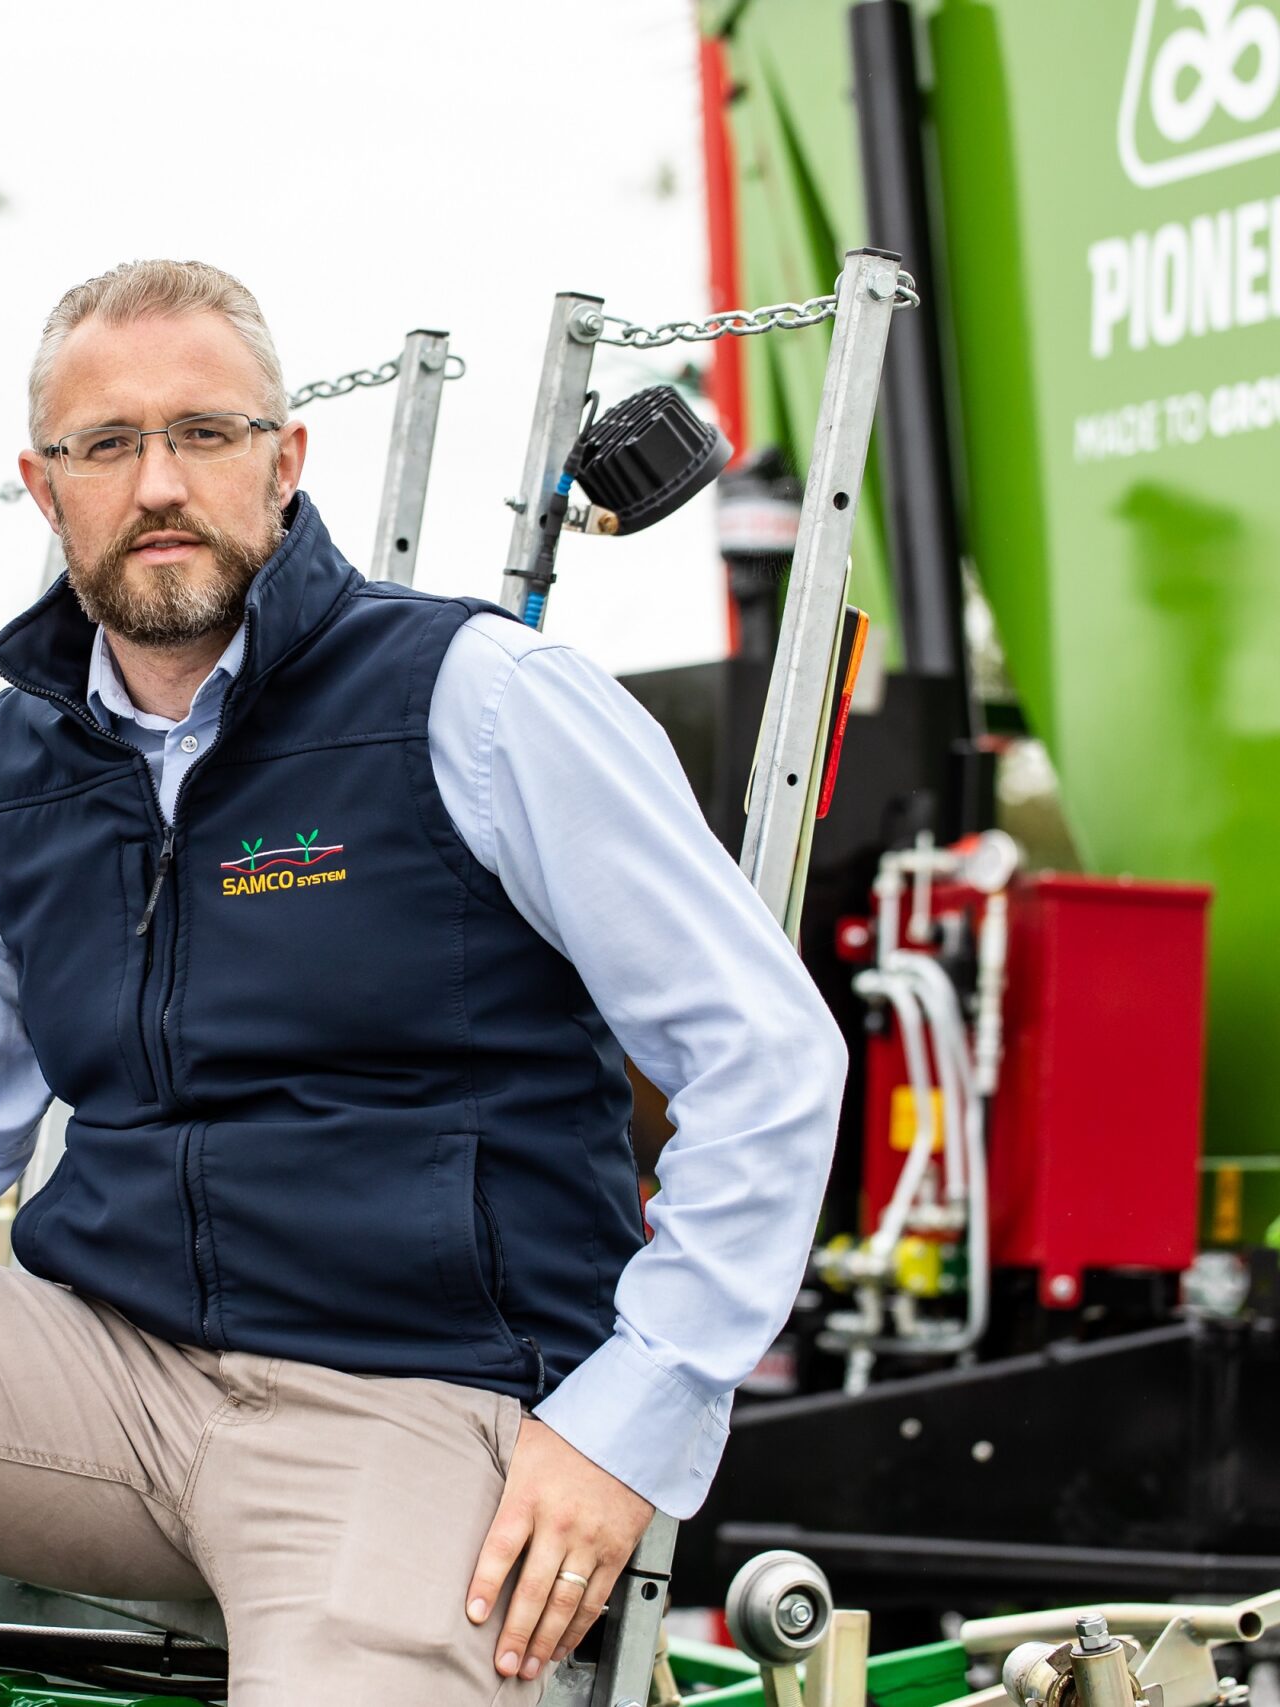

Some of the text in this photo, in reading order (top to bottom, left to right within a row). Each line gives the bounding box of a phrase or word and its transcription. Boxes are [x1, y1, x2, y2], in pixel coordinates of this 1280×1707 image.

[1165, 390, 1206, 444] TO
[1209, 374, 1280, 437] GRO
[222, 869, 346, 895] SAMCO SYSTEM
